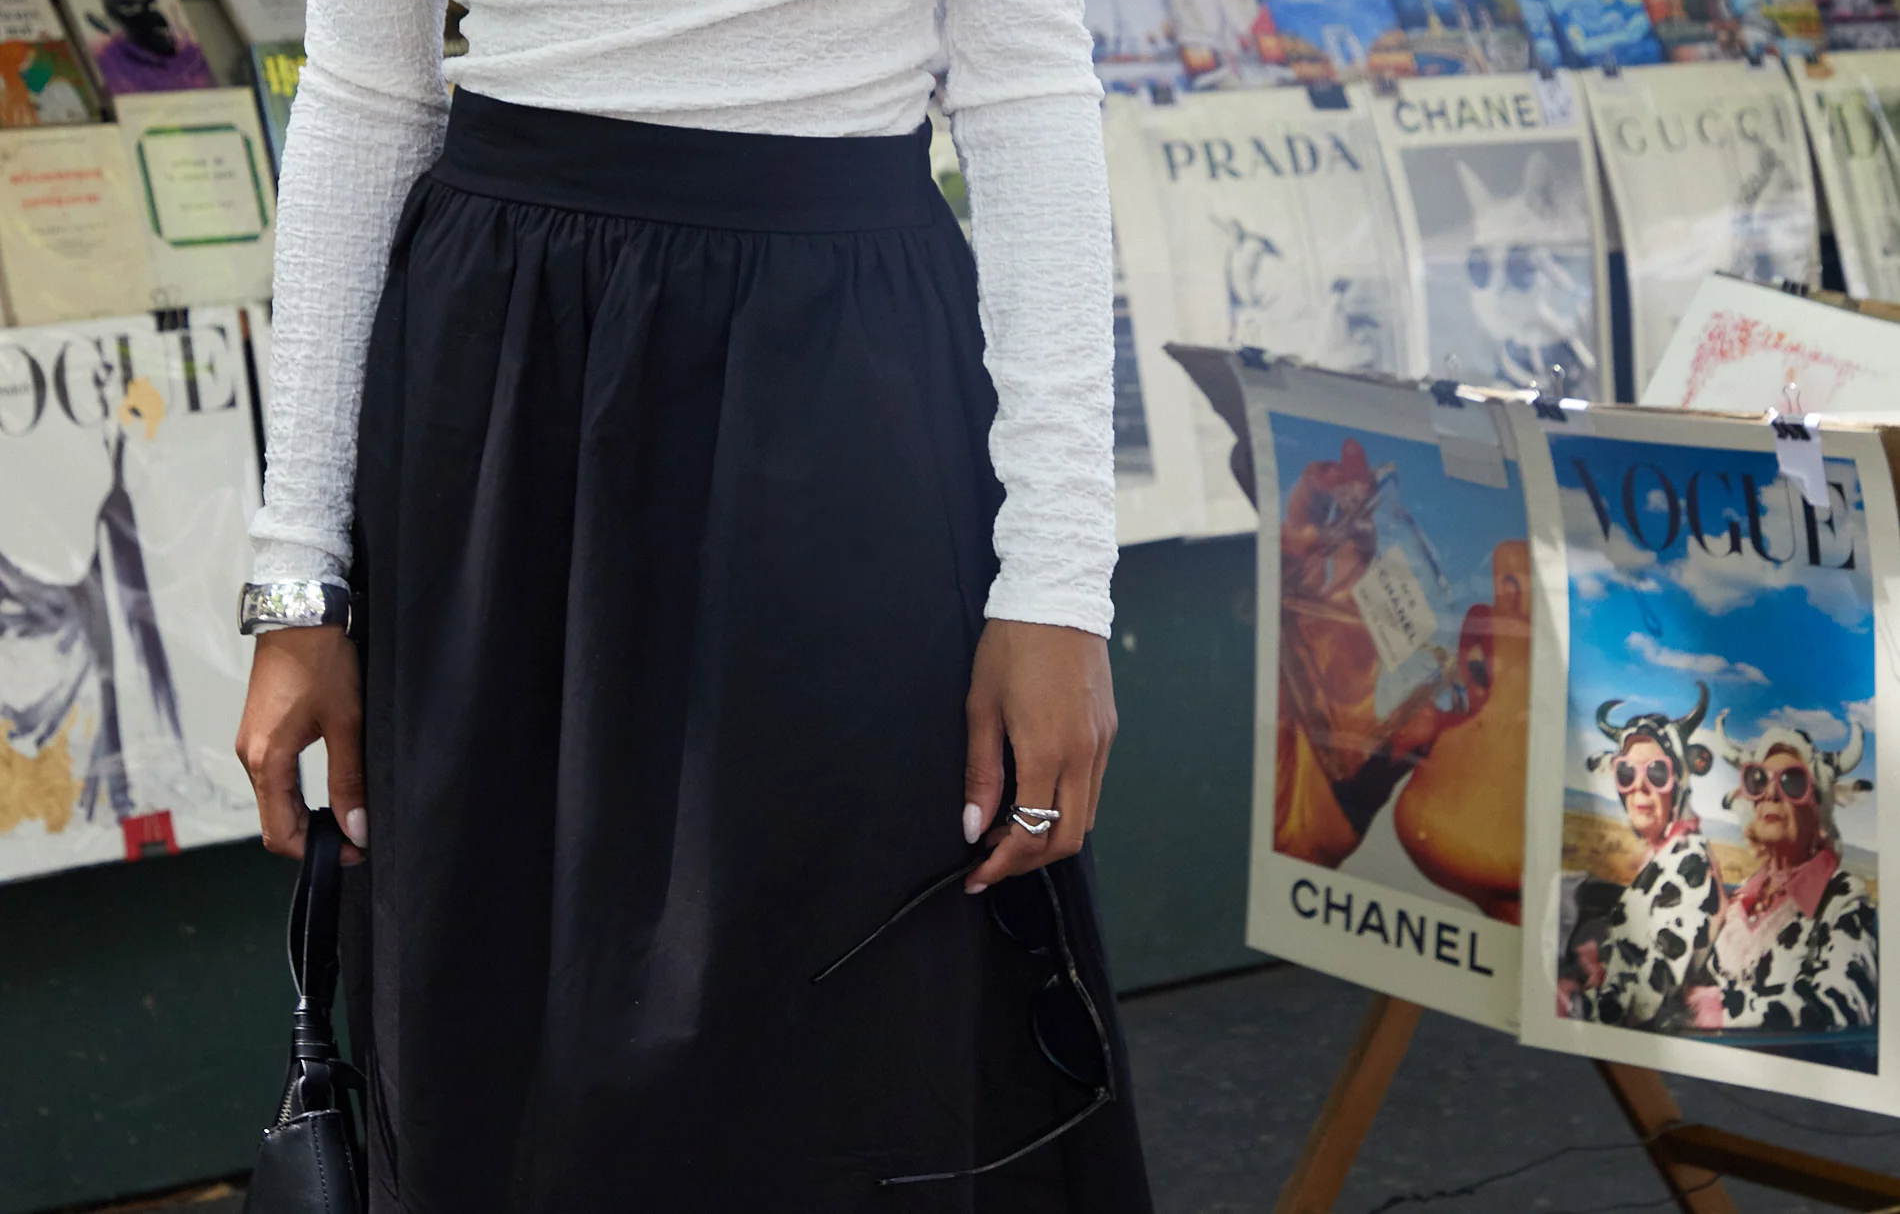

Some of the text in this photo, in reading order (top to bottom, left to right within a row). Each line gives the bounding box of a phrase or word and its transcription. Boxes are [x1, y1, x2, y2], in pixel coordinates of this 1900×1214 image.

[1394, 92, 1538, 134] CHANE
[1614, 97, 1788, 156] GUCCI
[1162, 132, 1362, 182] PRADA
[1572, 458, 1856, 571] VOGUE
[1290, 878, 1495, 977] CHANEL
